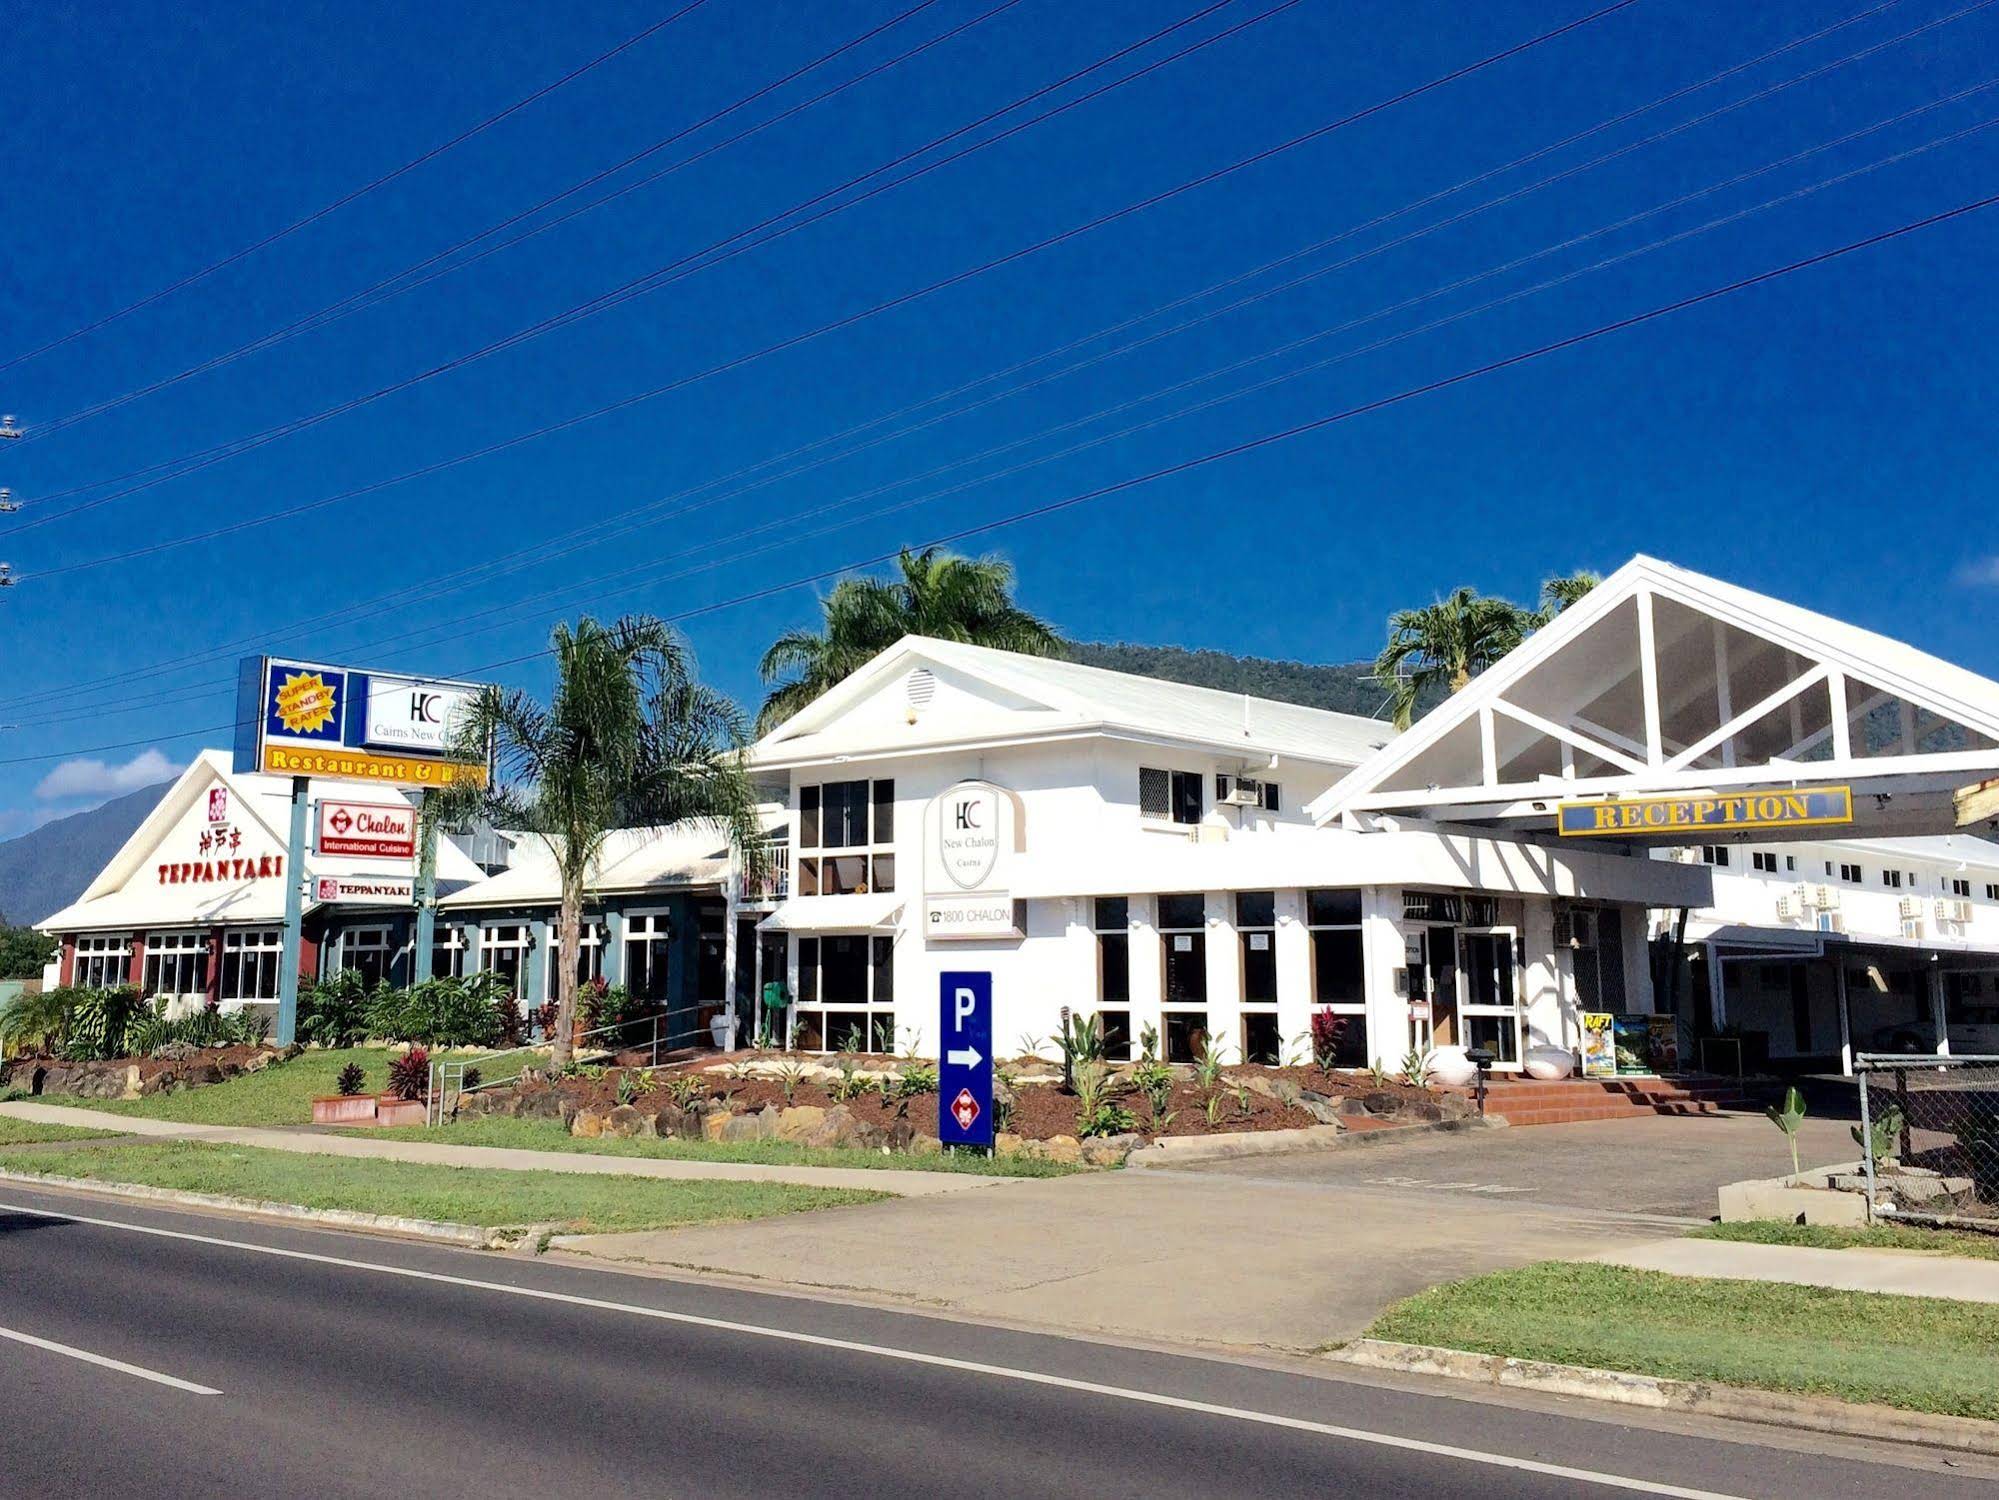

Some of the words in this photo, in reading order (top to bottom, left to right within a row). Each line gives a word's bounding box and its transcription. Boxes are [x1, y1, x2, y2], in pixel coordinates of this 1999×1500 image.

[279, 679, 317, 700] SUPER
[279, 687, 330, 716] STANDBY
[290, 705, 329, 726] RATES
[374, 724, 408, 739] Cairns
[411, 727, 436, 741] New
[271, 750, 406, 778] Restaurant
[414, 763, 432, 780] &
[1593, 794, 1810, 829] RECEPTION
[356, 812, 406, 835] Chalon
[324, 841, 377, 853] International
[379, 843, 410, 854] Cuisine
[944, 838, 962, 849] New
[964, 836, 995, 849] Chalon
[158, 855, 283, 885] TEPPANYAKI
[339, 885, 411, 896] TEPPANYAKI
[943, 910, 964, 922] 1800
[966, 908, 1010, 922] CHALON
[955, 987, 976, 1032] P
[1584, 1014, 1611, 1028] RAFT
